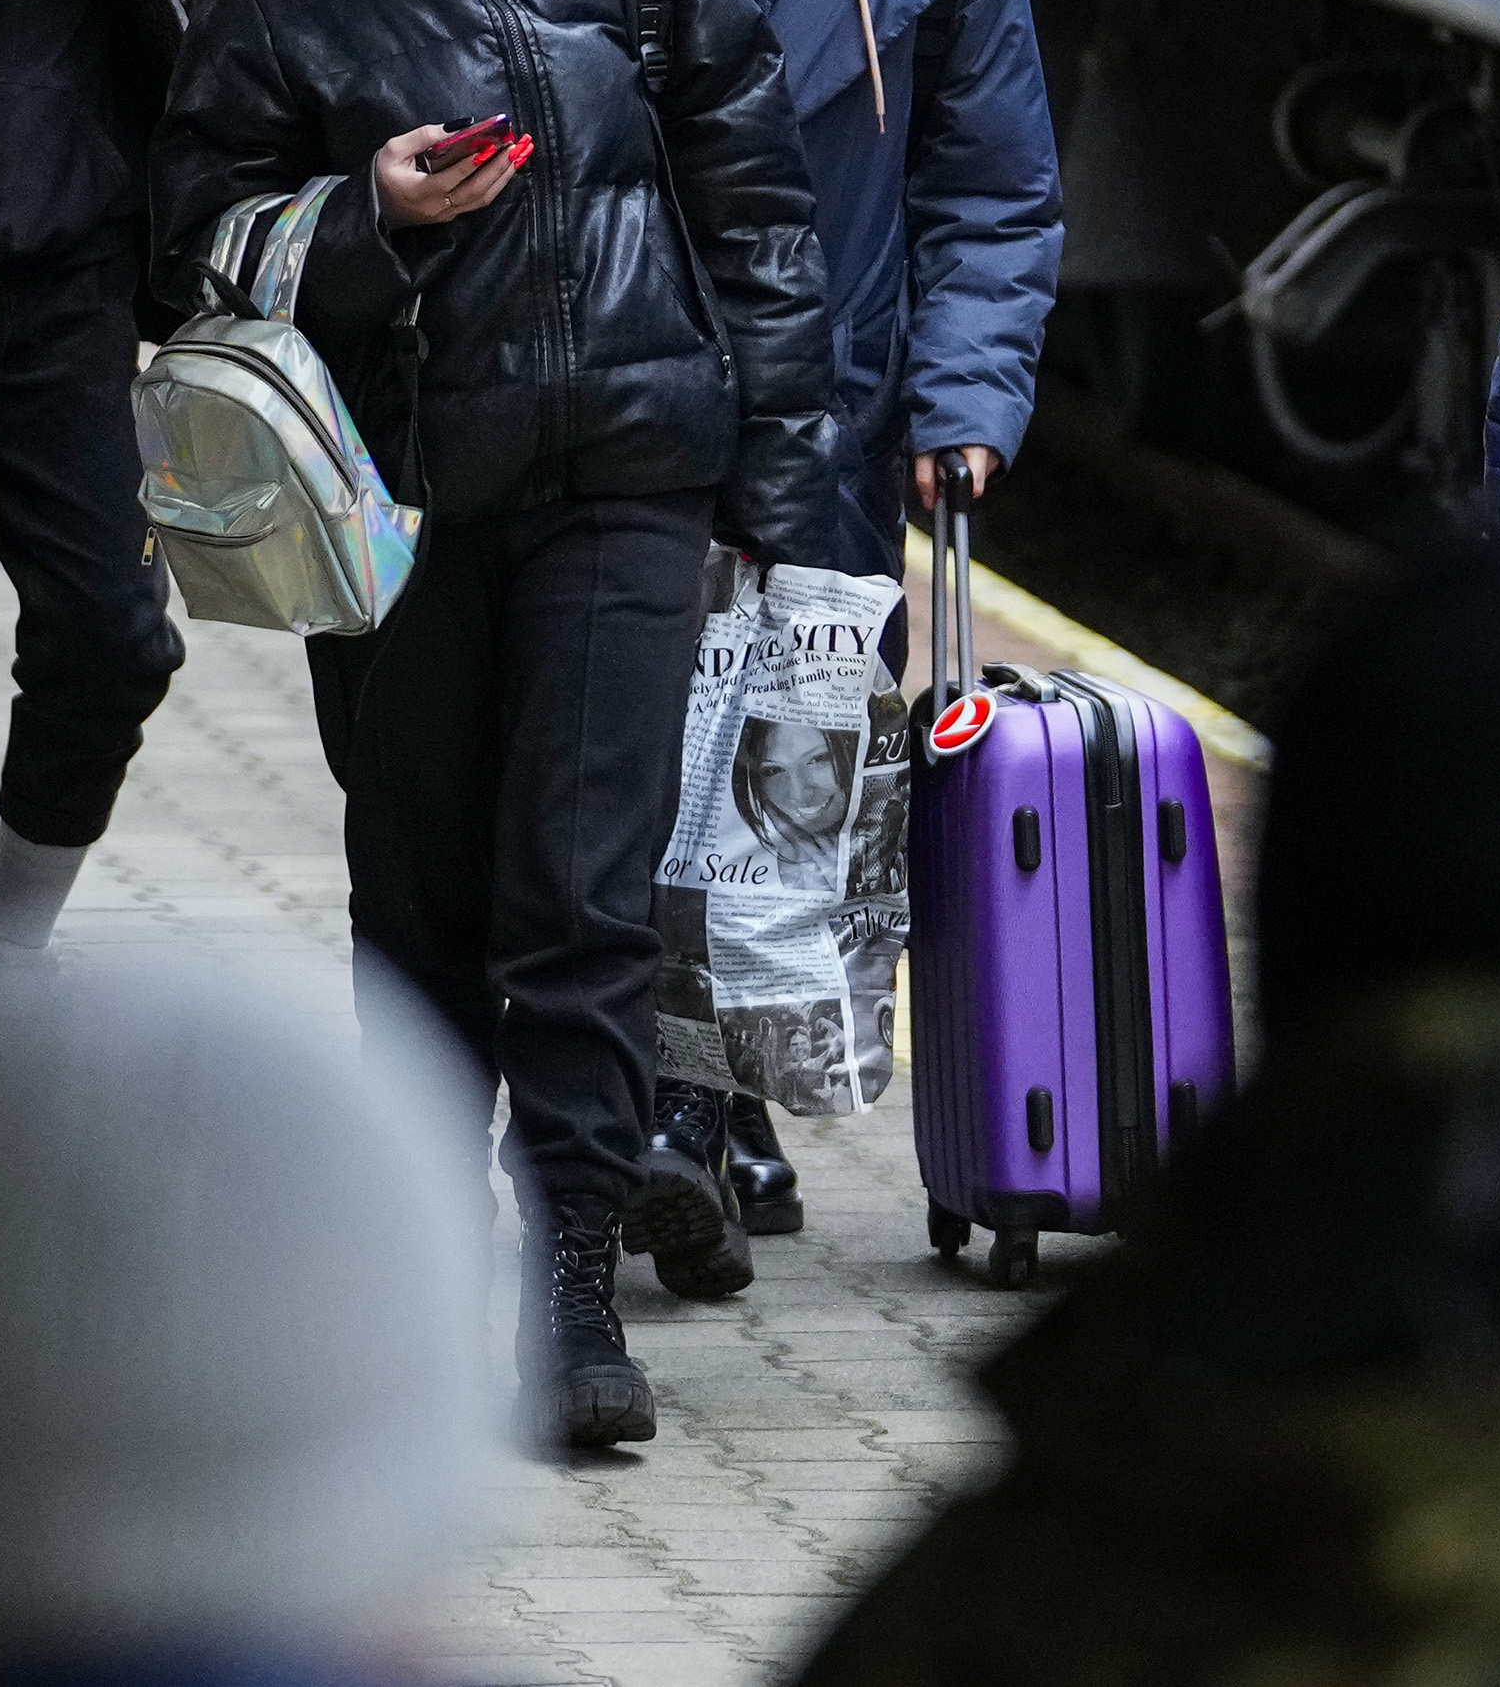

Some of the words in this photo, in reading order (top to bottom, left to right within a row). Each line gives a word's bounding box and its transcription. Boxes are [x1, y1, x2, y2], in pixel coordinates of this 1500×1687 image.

[790, 623, 876, 655] SITY
[743, 679, 791, 695] Freaking
[791, 667, 832, 687] Family
[837, 665, 865, 678] Guy
[698, 853, 769, 885] Sale
